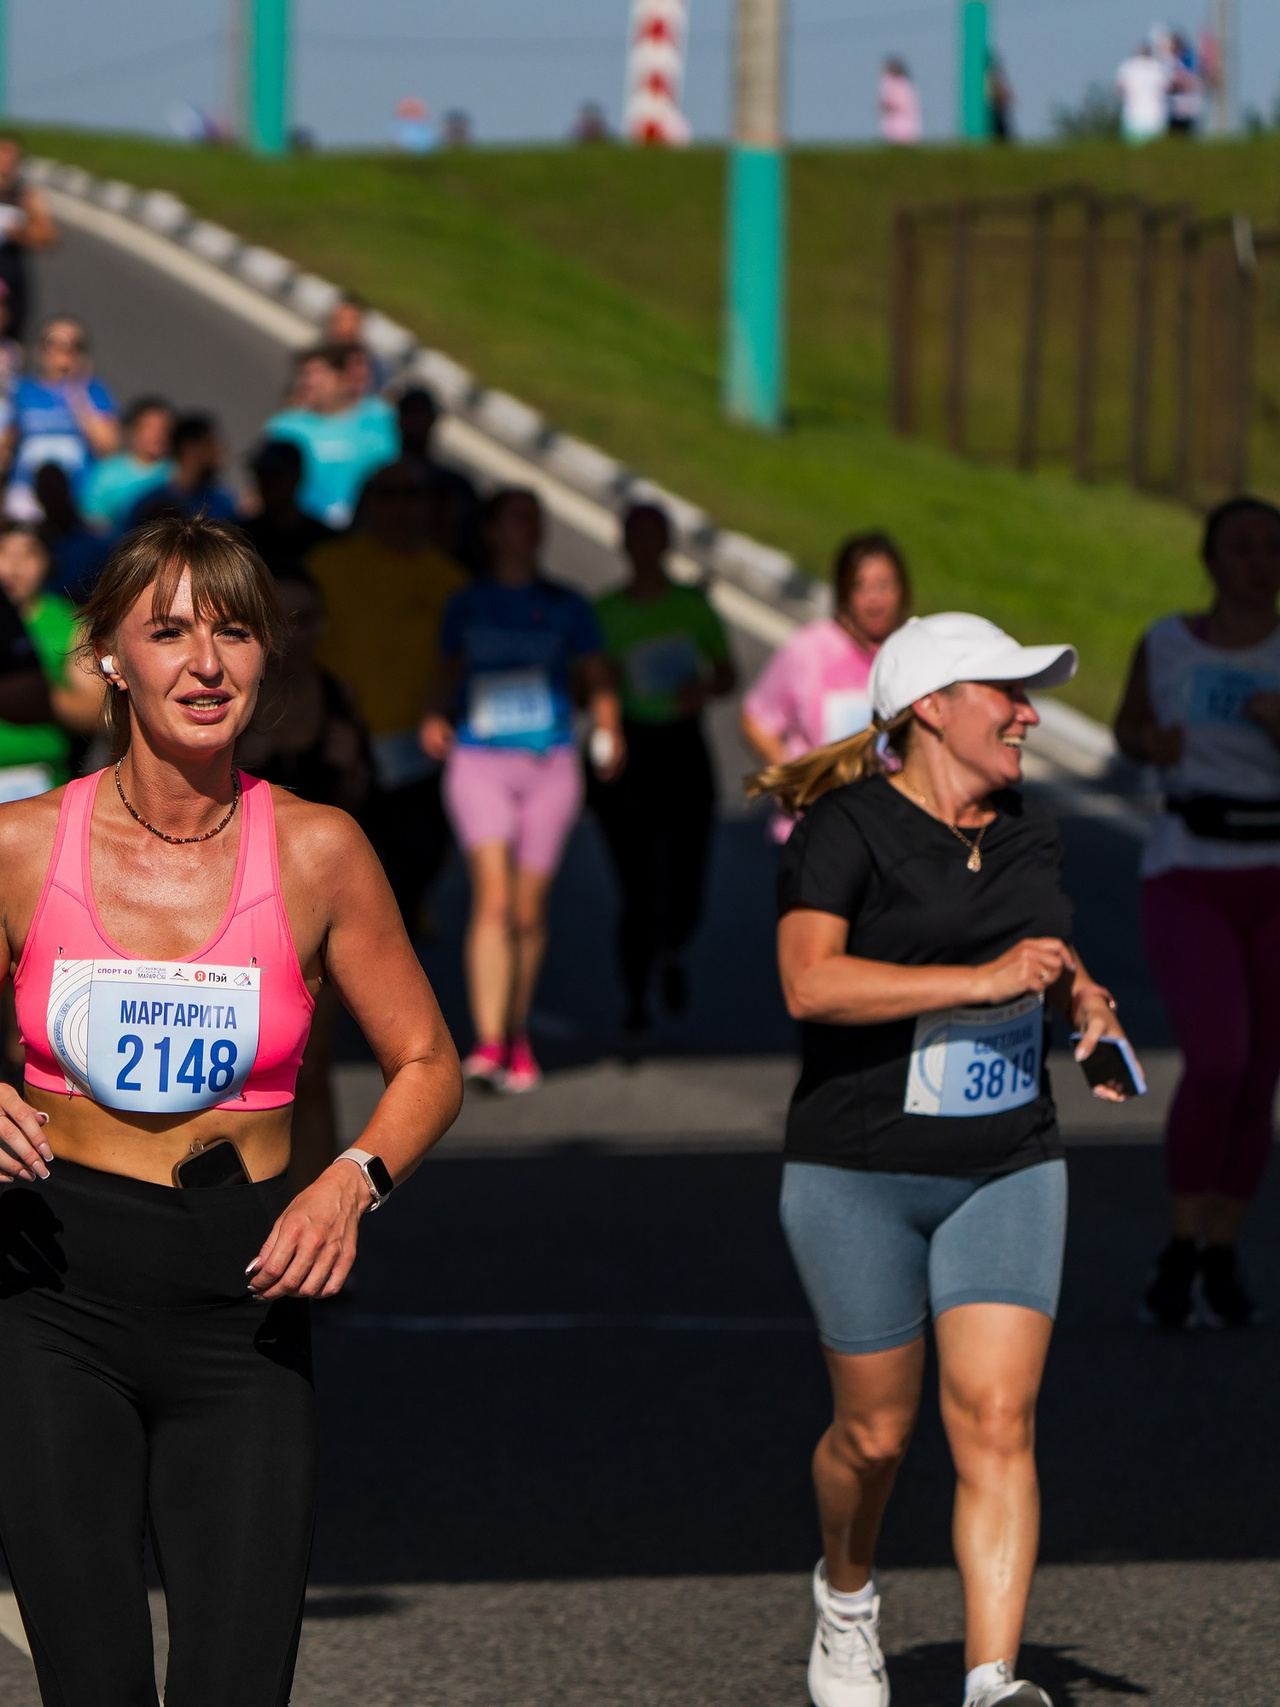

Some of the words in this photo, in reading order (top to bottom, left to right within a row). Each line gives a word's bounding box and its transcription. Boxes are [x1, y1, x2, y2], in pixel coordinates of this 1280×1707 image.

[208, 972, 227, 983] Пэй
[120, 1000, 238, 1030] МАРГАРИТА
[116, 1034, 238, 1094] 2148
[964, 1048, 1036, 1101] 3819
